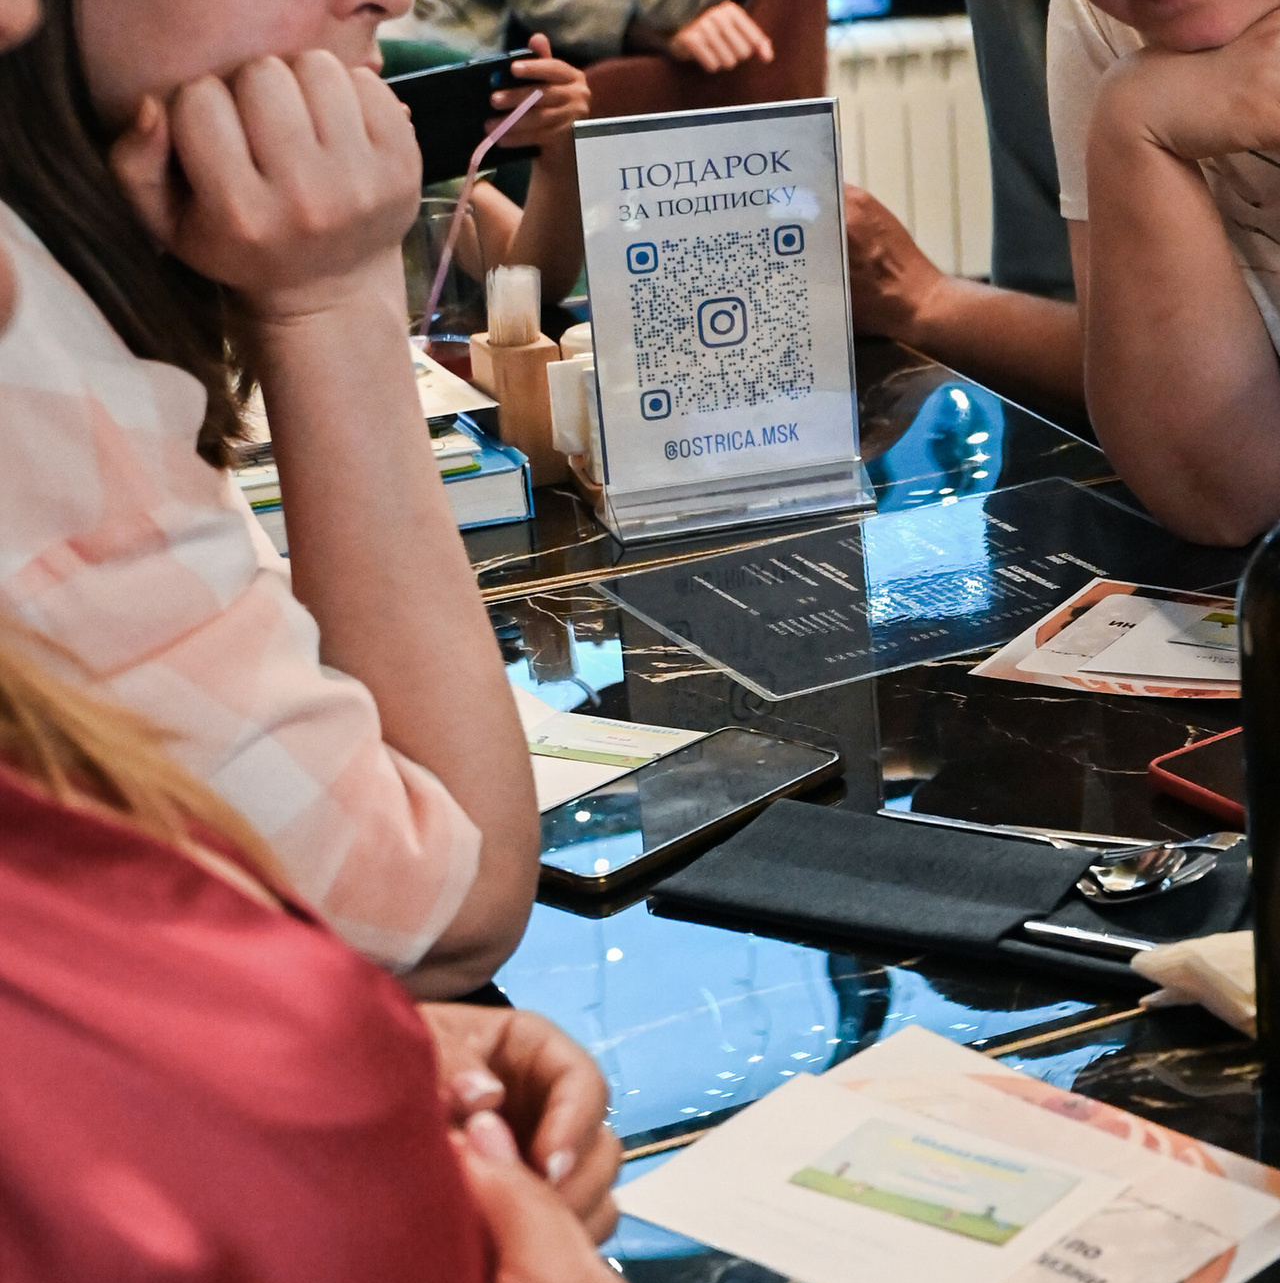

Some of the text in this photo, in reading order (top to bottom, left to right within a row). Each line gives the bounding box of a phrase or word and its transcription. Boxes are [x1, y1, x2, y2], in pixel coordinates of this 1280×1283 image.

[618, 149, 792, 191] ПОДАРОК
[618, 185, 797, 222] ЗА ПОДПИСКУ
[664, 422, 800, 461] @OSTRICA.MSK
